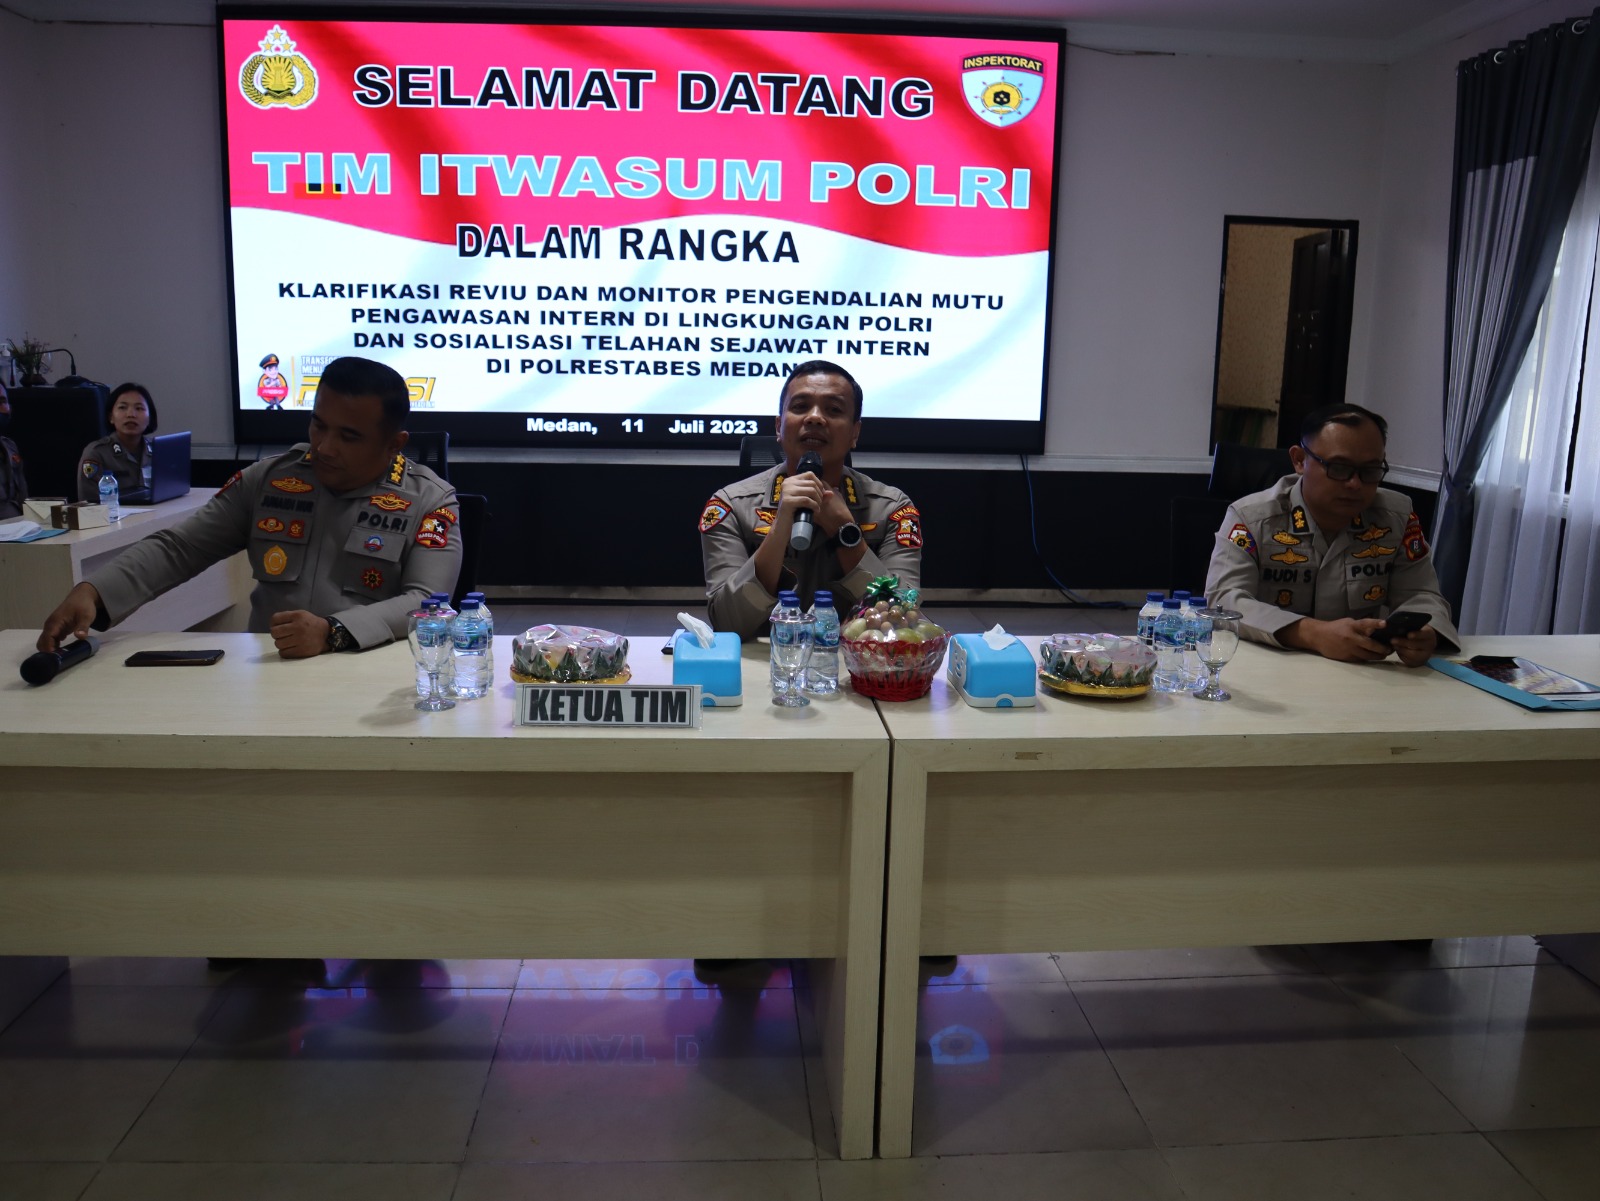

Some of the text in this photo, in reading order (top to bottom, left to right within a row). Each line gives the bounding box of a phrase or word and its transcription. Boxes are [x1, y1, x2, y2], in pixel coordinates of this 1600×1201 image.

[964, 55, 1043, 72] INSPEKTORAT
[354, 65, 934, 119] SELAMAT DATANG
[252, 151, 1031, 209] TIM ITWASUM POLRI
[456, 224, 800, 263] DALAM RANGKA
[278, 282, 1004, 310] KLARIFIKASI REVIU DAN MONITOR PENGENDALIAN MUTU
[351, 308, 932, 332] PENGAWASAN INTERN DI LINGKUNGAN POLRI
[353, 332, 930, 357] DAN SOSIALISASI TELAHAN SEJAWAT INTERN
[487, 358, 797, 378] DI POLRESTABES MEDAN
[526, 417, 758, 436] Medan, 11 Juli 2023
[357, 511, 408, 533] POLRI
[1263, 568, 1312, 583] BUDI S
[1352, 562, 1393, 577] POLR
[529, 688, 687, 723] KETUA TIM
